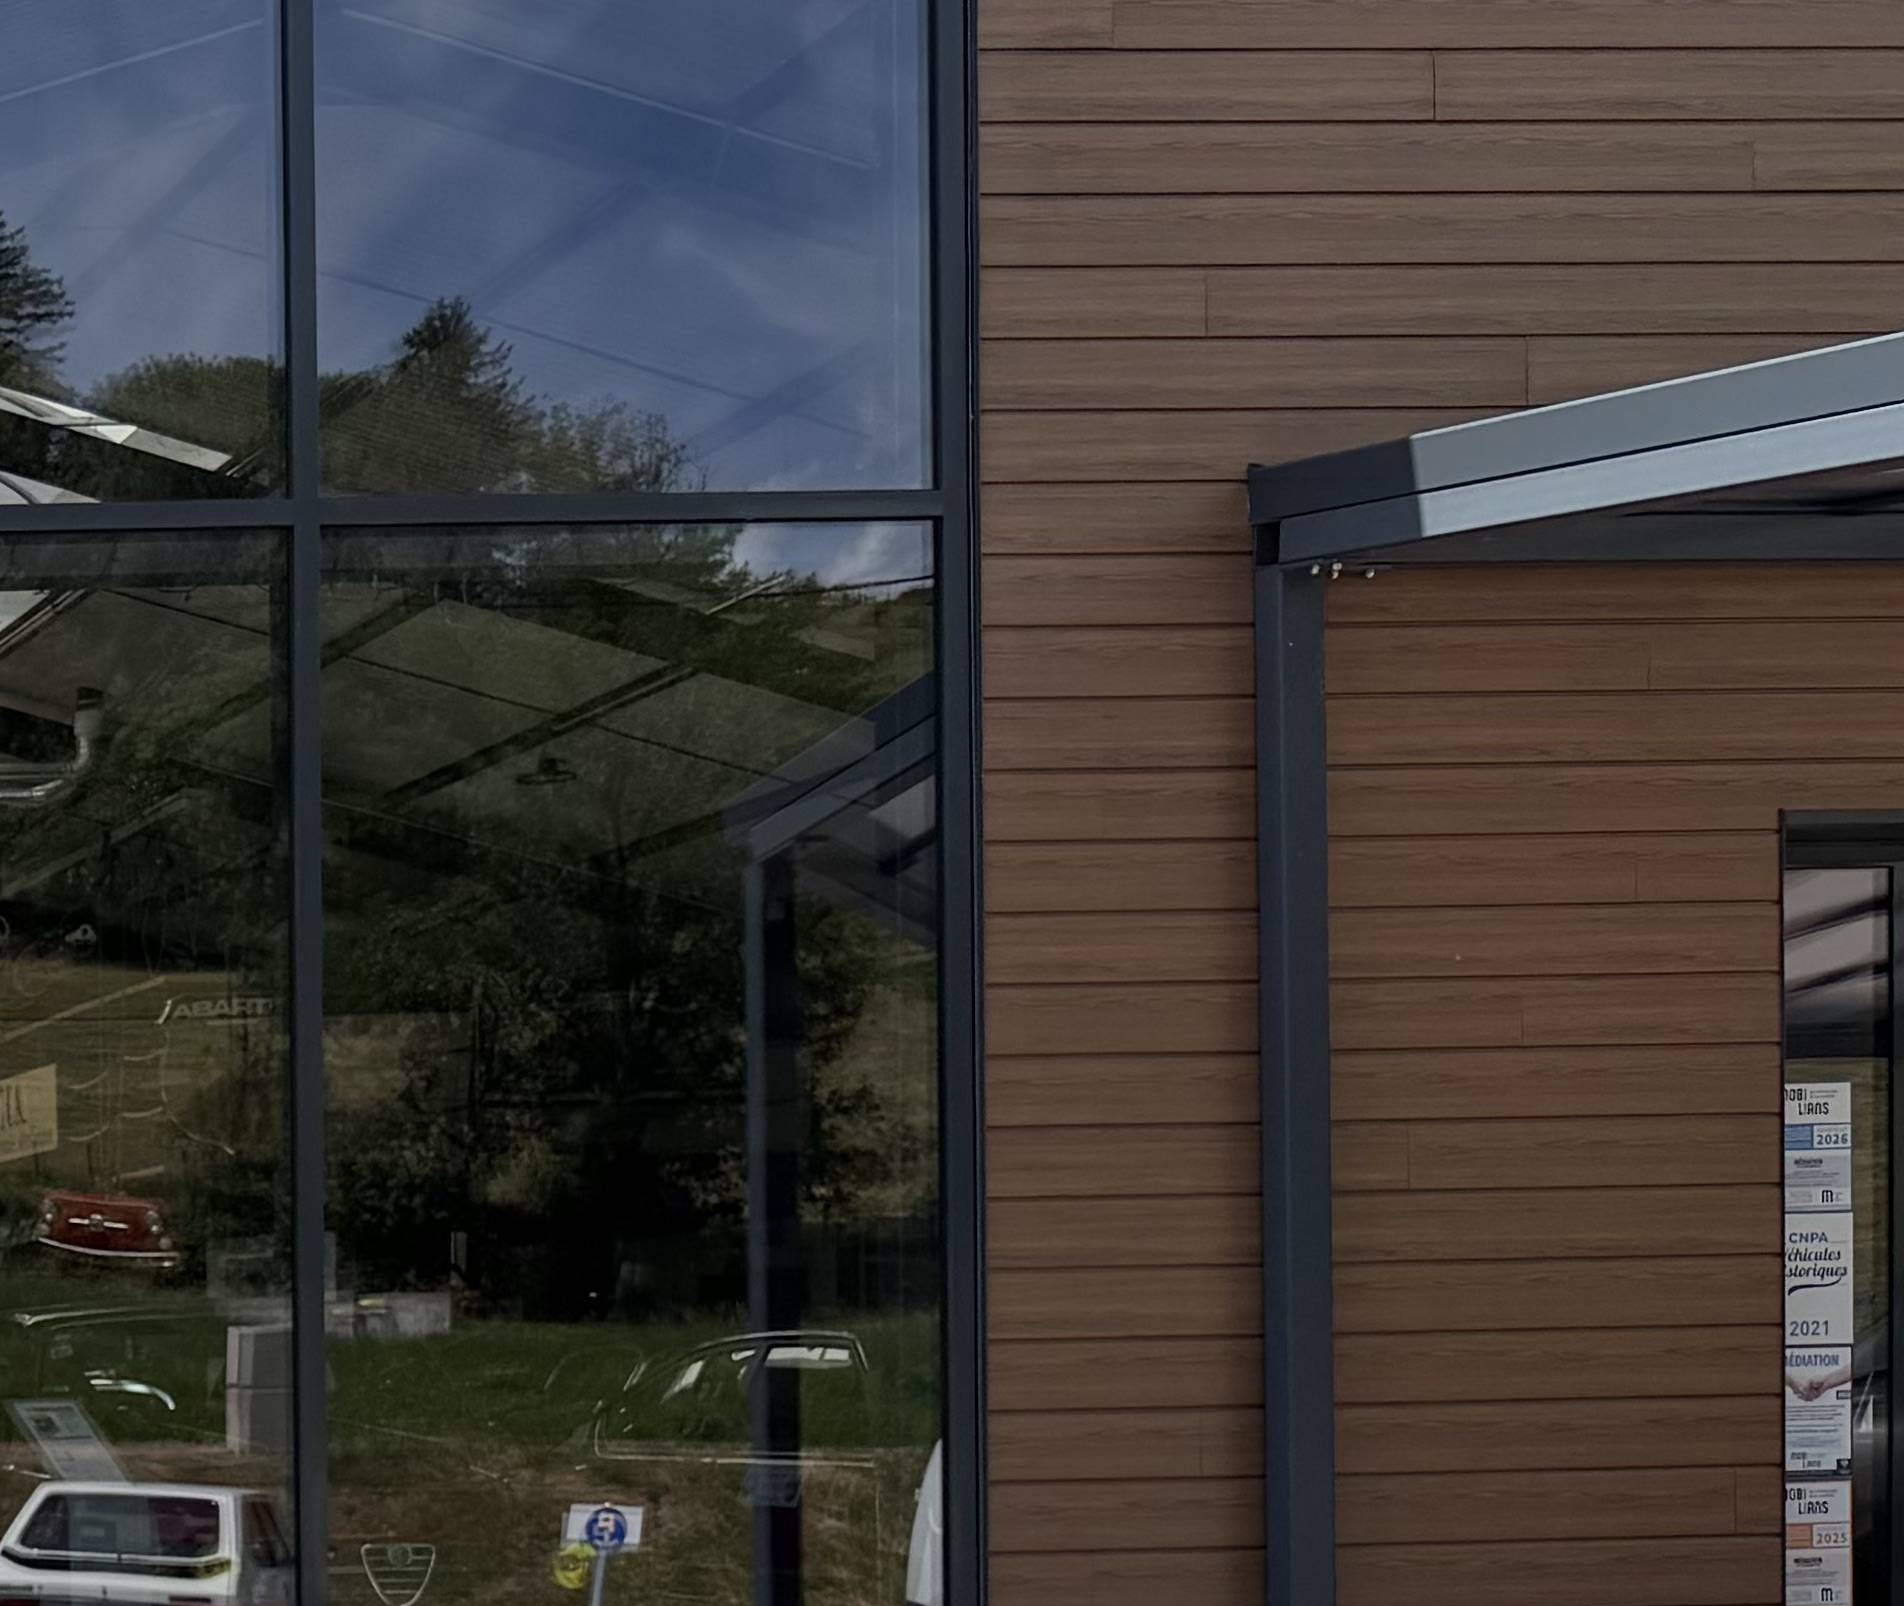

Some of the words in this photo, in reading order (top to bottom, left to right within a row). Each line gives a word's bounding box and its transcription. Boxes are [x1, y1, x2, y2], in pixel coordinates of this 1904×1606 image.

[171, 997, 274, 1018] ABART
[1816, 1134, 1848, 1145] 2026
[1789, 1232, 1828, 1243] CNPA
[1784, 1246, 1841, 1262] éhicules
[1785, 1263, 1848, 1281] storiques
[1790, 1320, 1829, 1337] 2021
